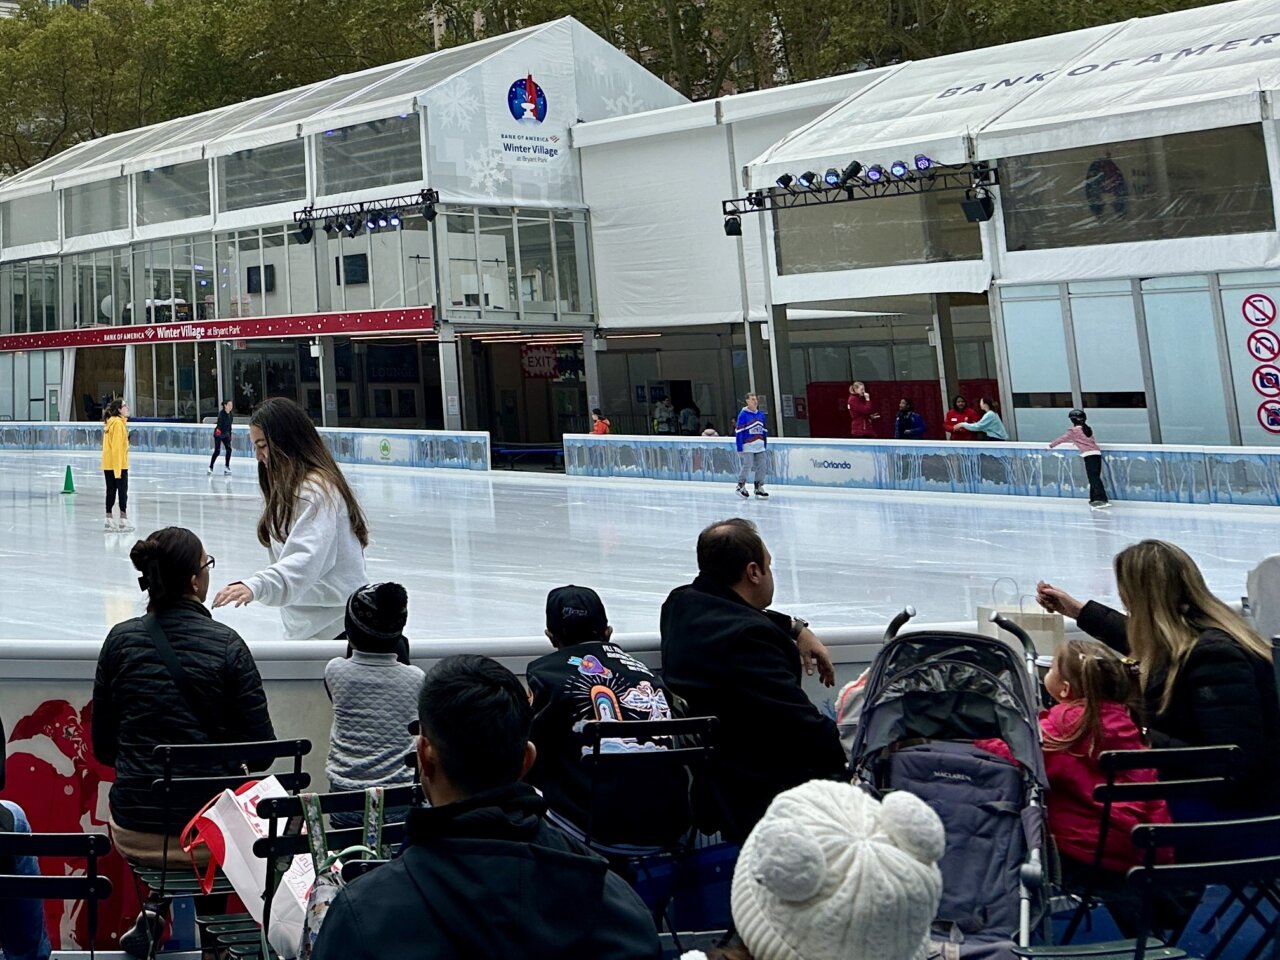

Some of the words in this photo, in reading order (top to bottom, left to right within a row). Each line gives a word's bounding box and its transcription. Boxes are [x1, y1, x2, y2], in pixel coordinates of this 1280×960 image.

[937, 68, 1061, 100] BANK
[1066, 57, 1130, 77] OF
[503, 142, 531, 154] Winter
[532, 145, 559, 157] Village
[104, 333, 117, 341] BANK
[123, 332, 145, 340] AMERICA
[157, 327, 180, 339] Winter
[181, 325, 205, 339] Village
[207, 328, 212, 336] at
[212, 327, 228, 337] Bryant
[228, 326, 240, 334] Park
[527, 356, 552, 368] EXIT
[933, 771, 972, 781] MACLAREN
